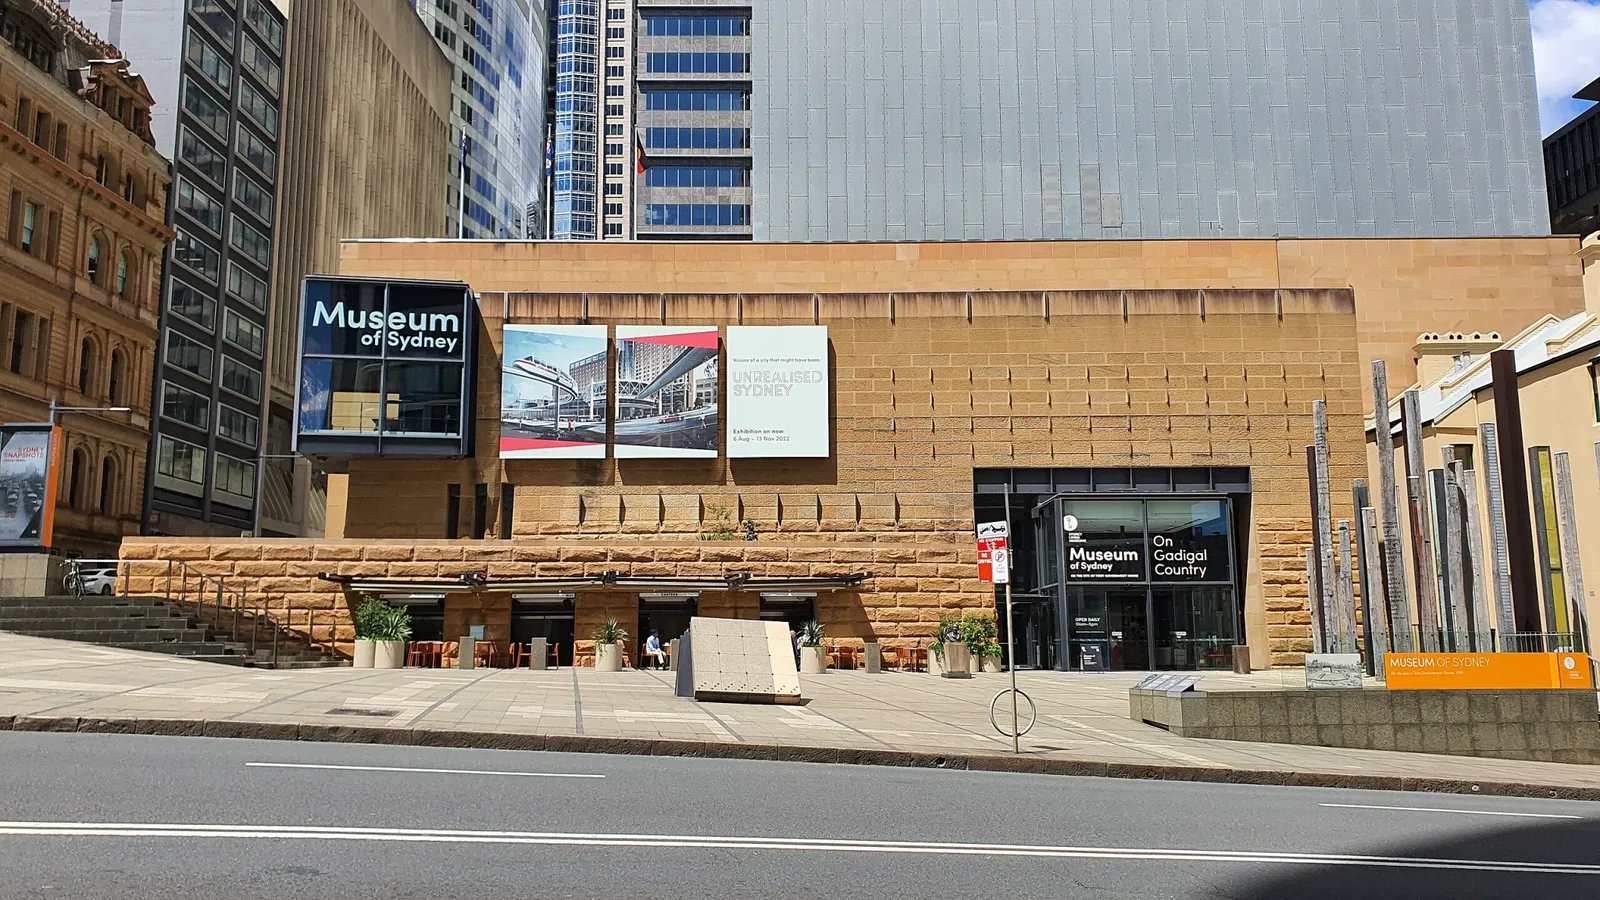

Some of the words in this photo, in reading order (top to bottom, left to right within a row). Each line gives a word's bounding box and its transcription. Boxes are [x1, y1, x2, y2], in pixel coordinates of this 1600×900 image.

[312, 300, 459, 332] Museum
[361, 331, 382, 346] of
[388, 331, 457, 352] Sydney
[732, 370, 824, 383] UNREALISED
[733, 384, 793, 396] SYDNEY
[1153, 535, 1173, 546] On
[1070, 548, 1139, 561] Museum
[1154, 549, 1207, 564] Gadigal
[1081, 562, 1113, 572] Sydney
[1155, 564, 1206, 578] Country
[1390, 657, 1434, 667] MUSEUM
[1437, 657, 1451, 667] OF
[1453, 657, 1490, 667] SYDNEY
